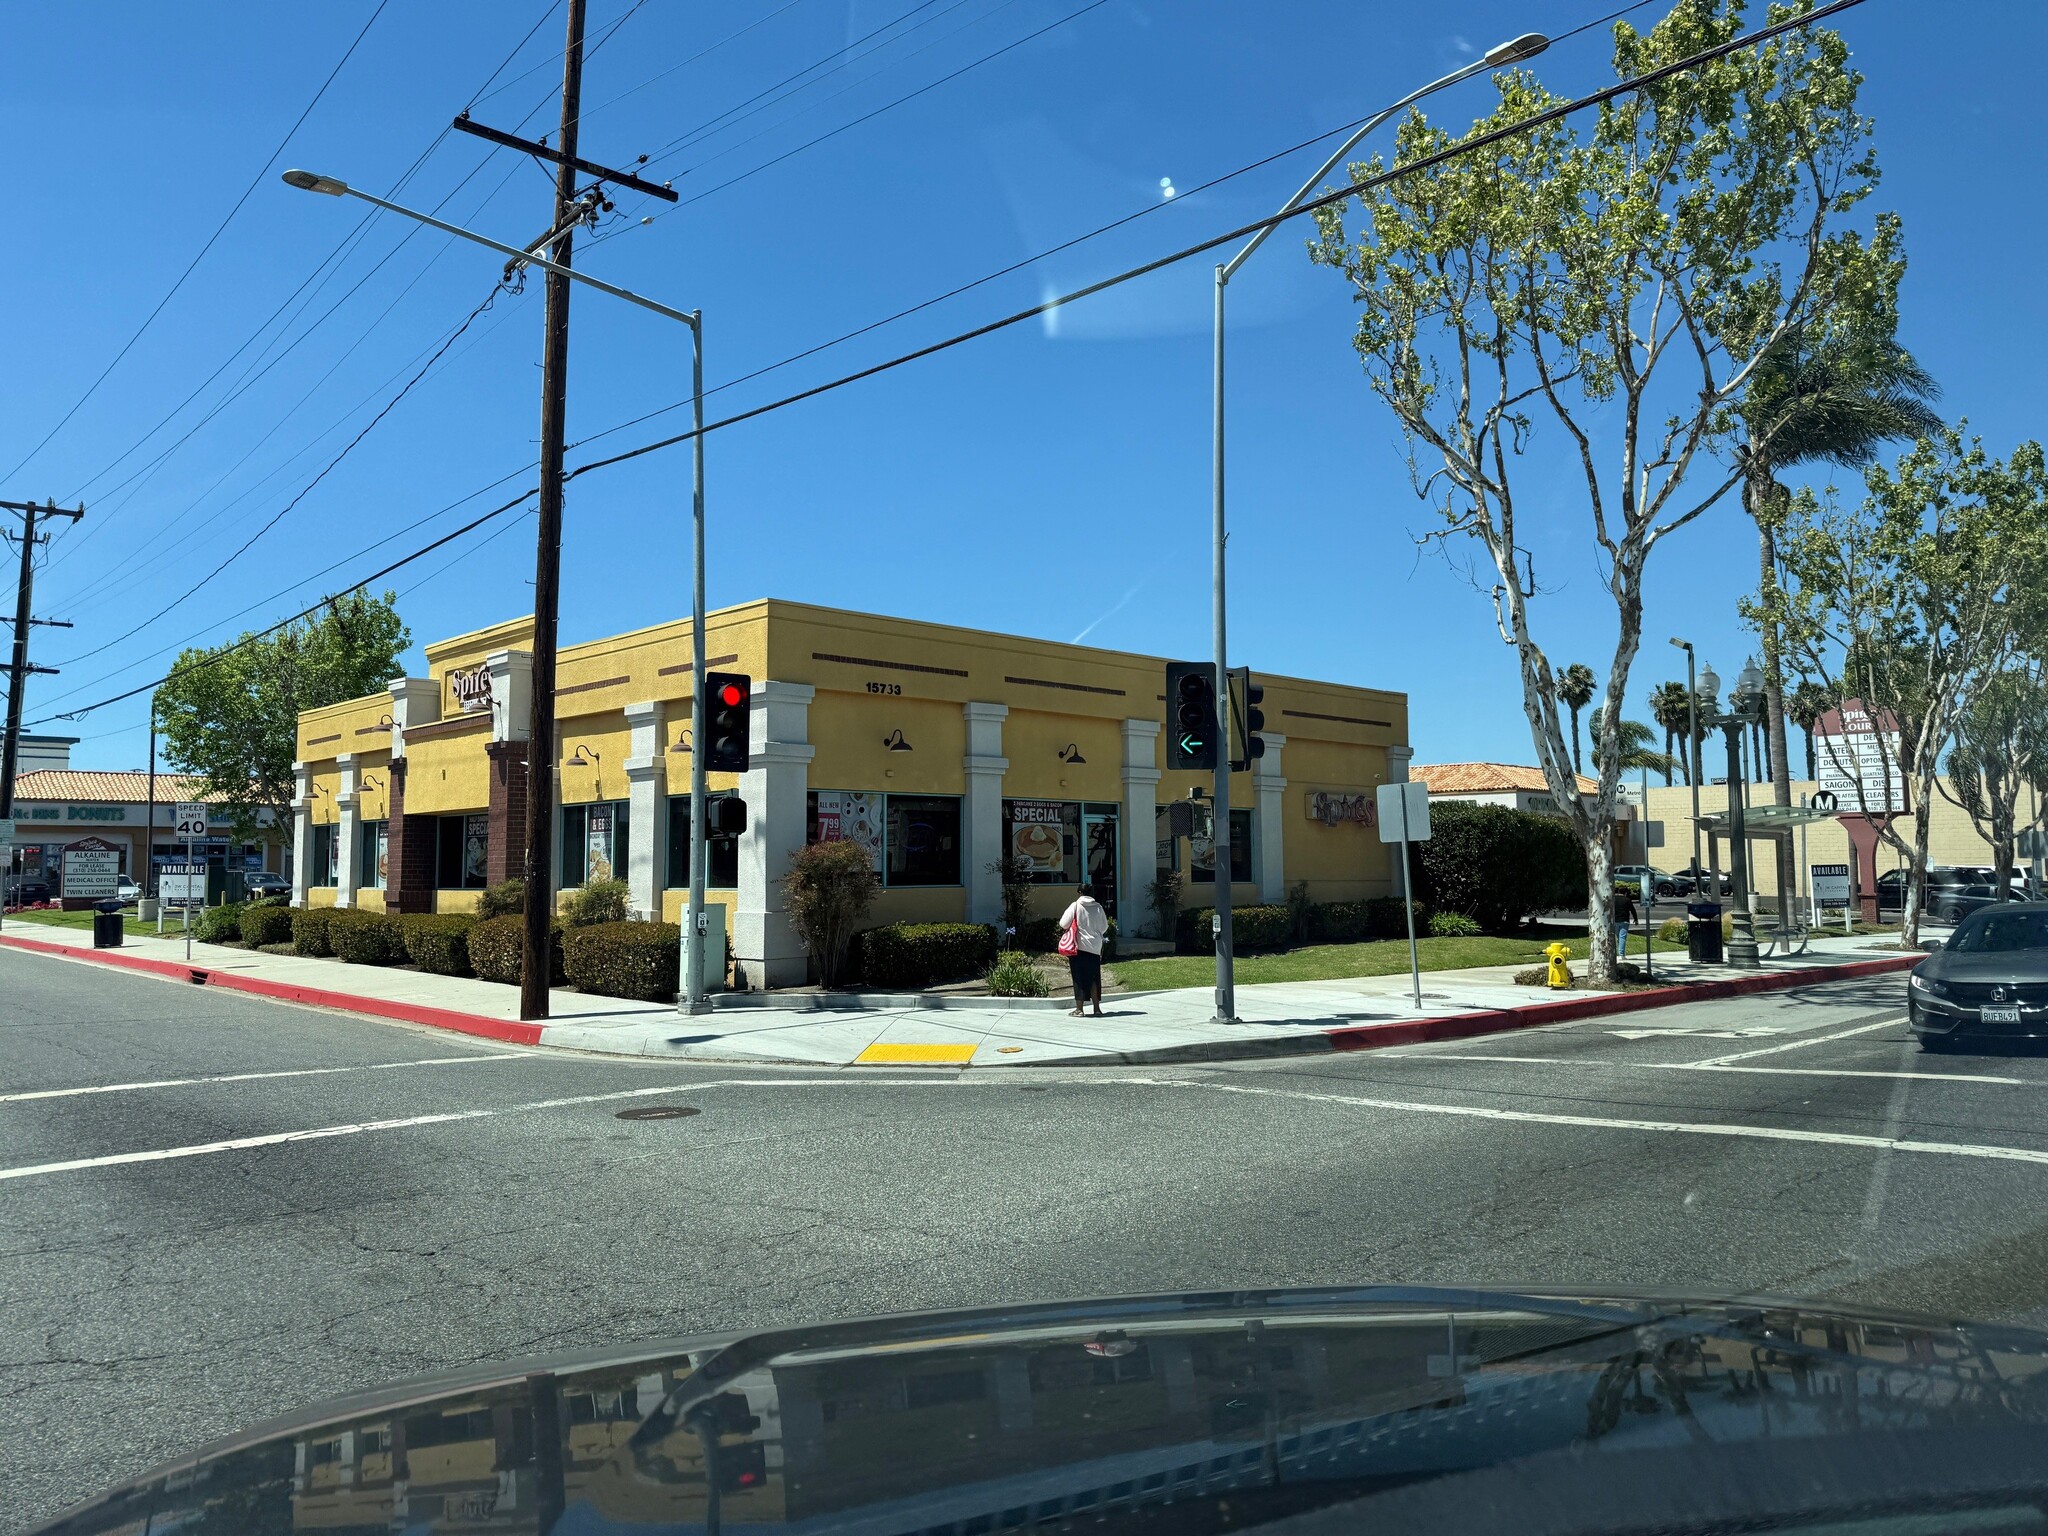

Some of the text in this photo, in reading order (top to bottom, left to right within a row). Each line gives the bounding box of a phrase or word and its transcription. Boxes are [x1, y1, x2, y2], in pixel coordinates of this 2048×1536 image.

[866, 682, 902, 695] 15733
[1823, 758, 1852, 766] DOUTS
[1865, 791, 1900, 799] CLEANRS
[67, 806, 125, 821] DONUTS
[1014, 807, 1062, 822] SPECIAL
[177, 821, 205, 834] 40
[1813, 866, 1847, 875] AVAILABLE
